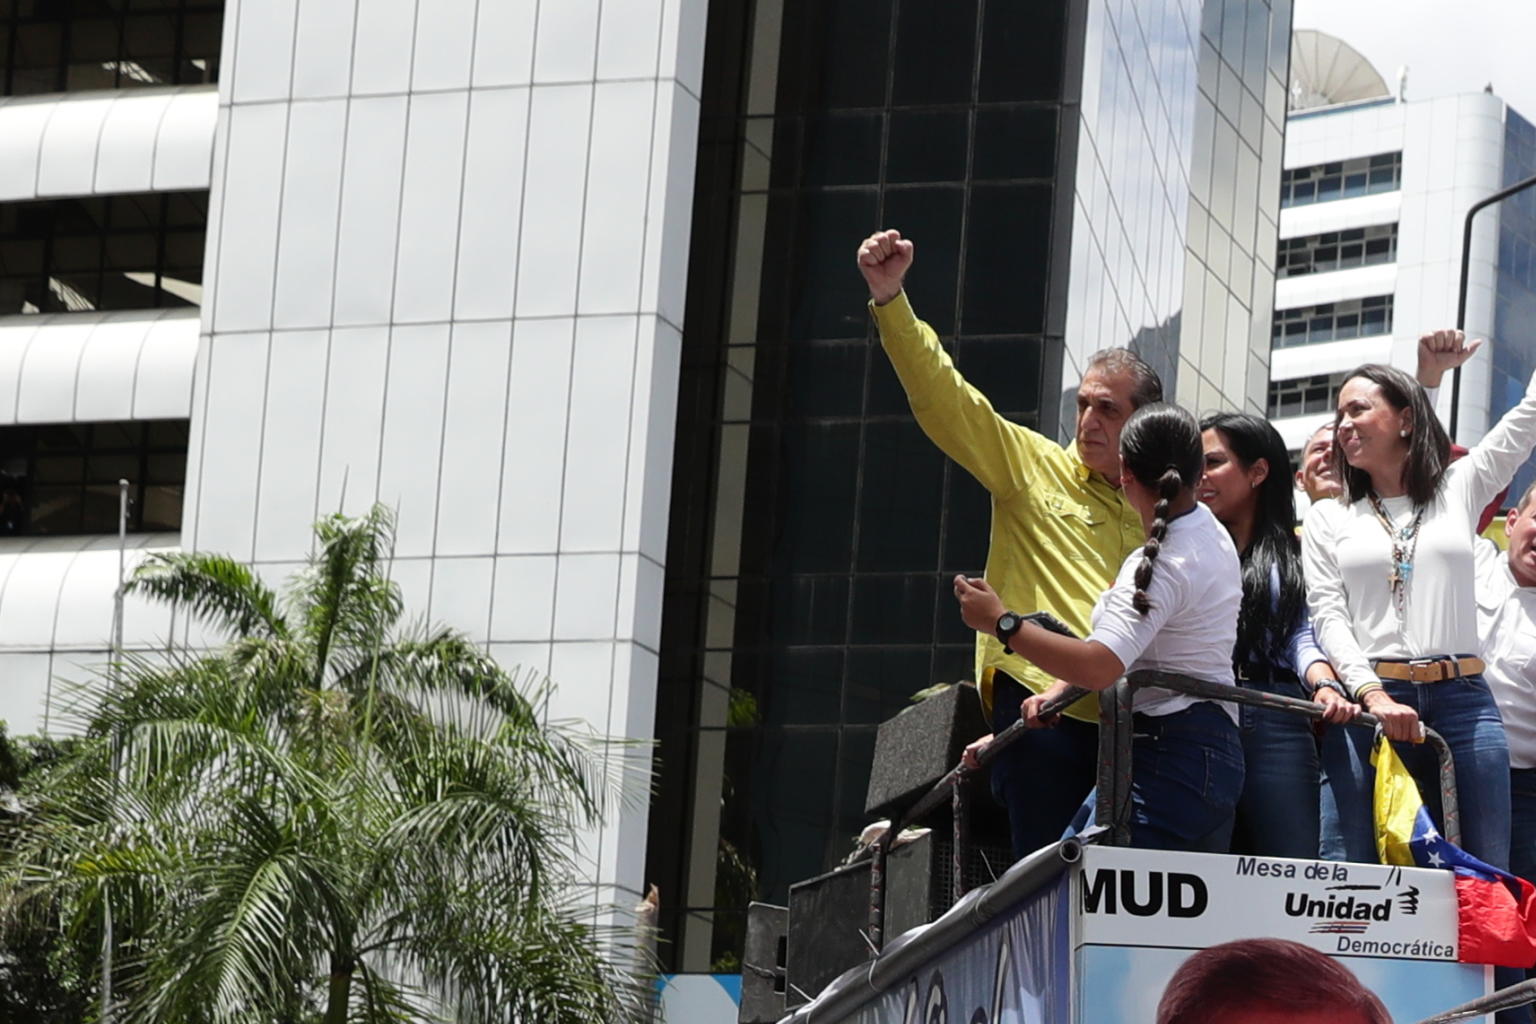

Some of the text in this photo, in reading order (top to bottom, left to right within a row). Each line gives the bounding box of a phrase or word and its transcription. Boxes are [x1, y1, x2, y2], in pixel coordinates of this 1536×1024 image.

[1236, 857, 1296, 878] Mesa
[1080, 868, 1208, 918] MUD
[1285, 893, 1392, 921] Unidad
[1337, 936, 1454, 957] Democrática
